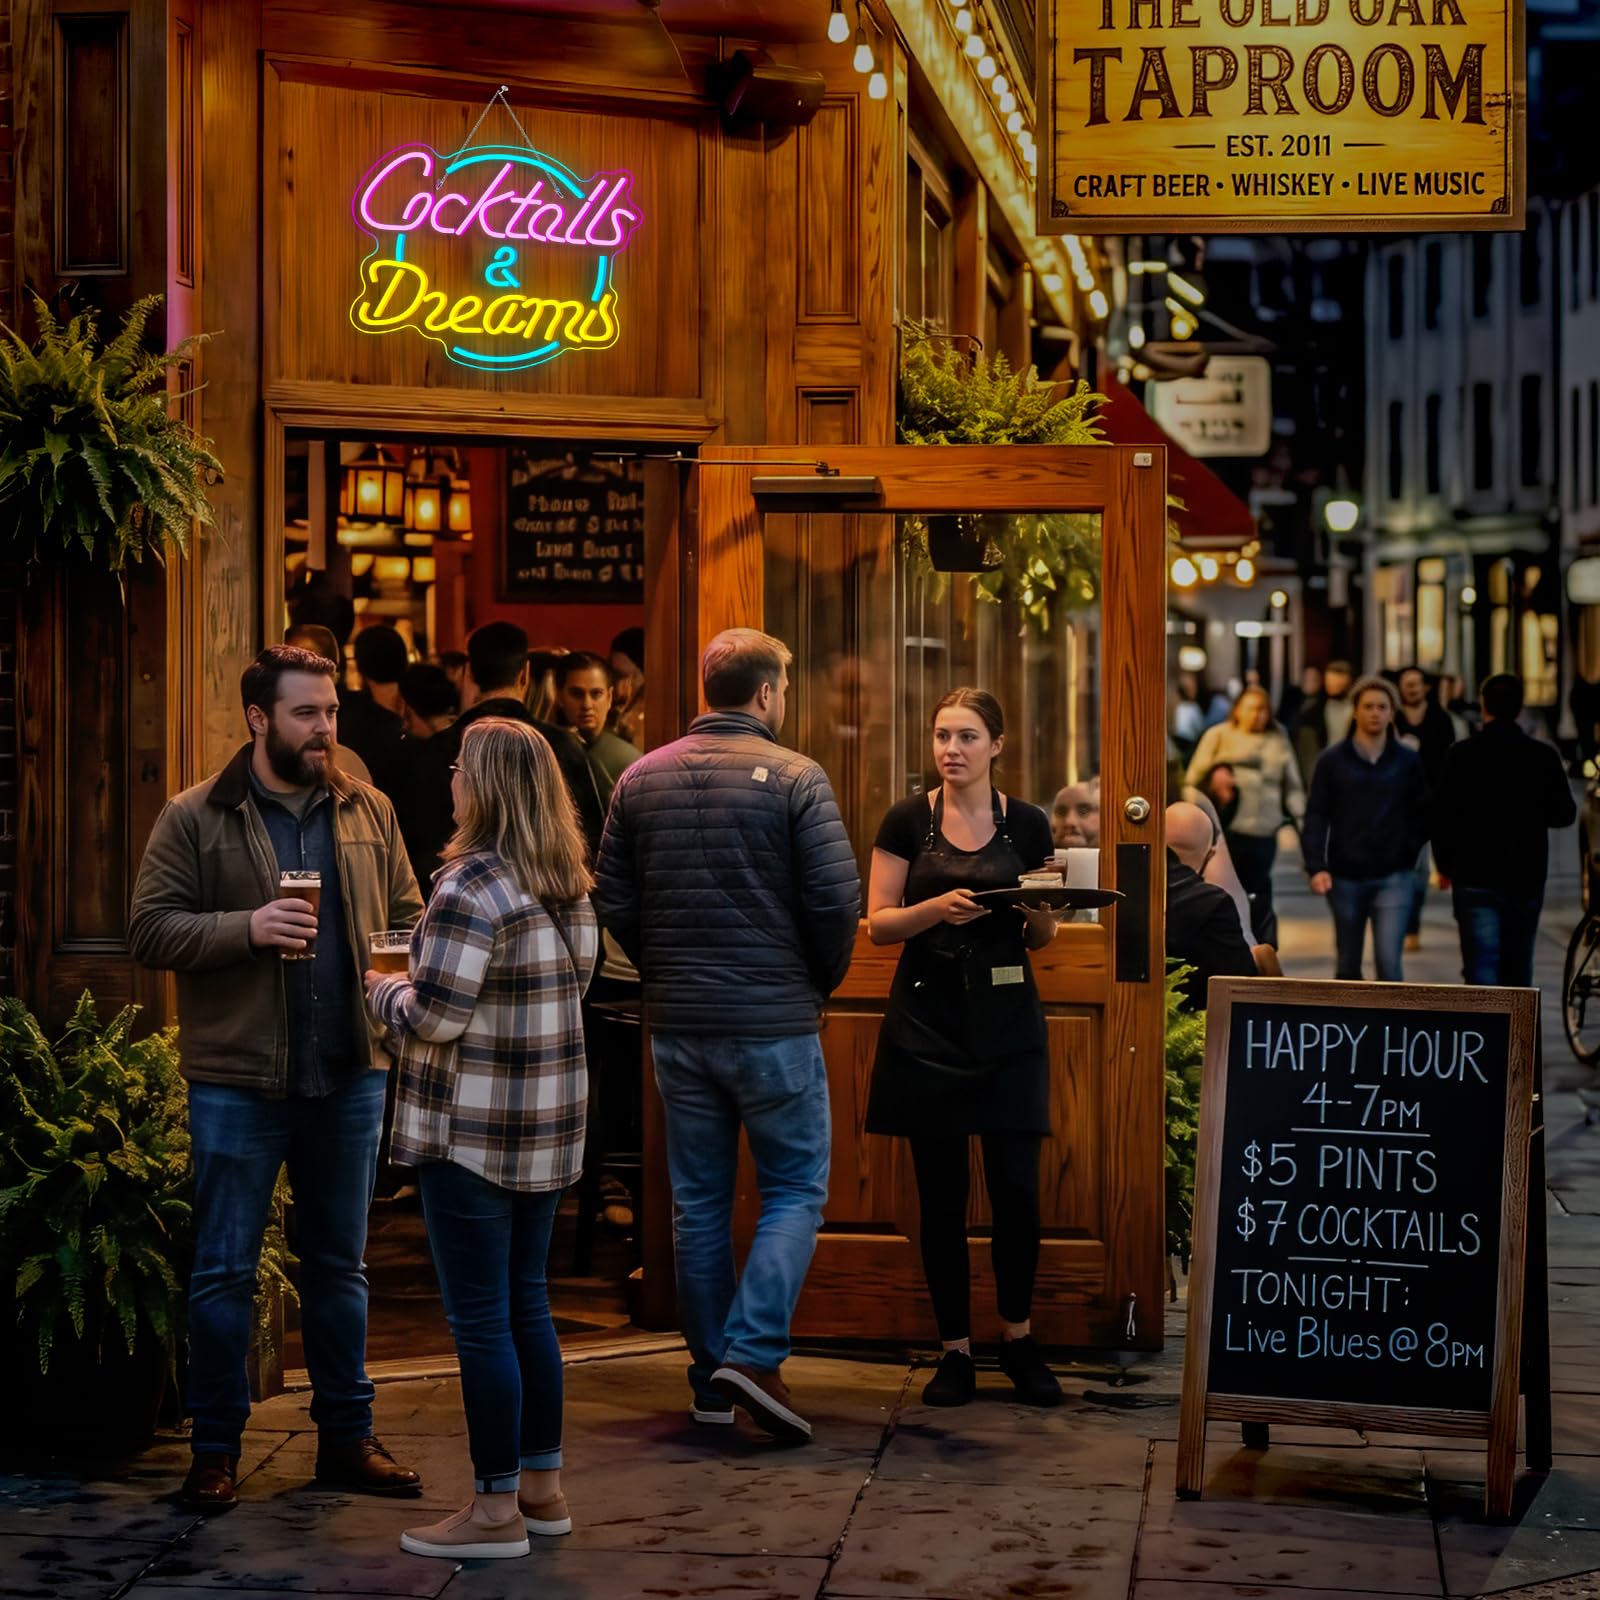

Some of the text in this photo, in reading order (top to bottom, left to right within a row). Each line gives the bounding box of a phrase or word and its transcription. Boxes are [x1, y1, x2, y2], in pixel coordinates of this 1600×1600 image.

[1073, 43, 1488, 127] TAPROOM
[1227, 135, 1332, 157] EST. 2011
[1074, 171, 1485, 198] CRAFT BEER WHISKEY LIVE MUSIC
[484, 246, 521, 288] &
[358, 259, 615, 343] Dreams
[1246, 1019, 1489, 1083] HAPPY HOUR
[1241, 1139, 1438, 1193] $5 PINTS
[1236, 1196, 1481, 1256] $7 COCKTAILS
[1230, 1268, 1410, 1313] TONIGHT:
[1225, 1313, 1484, 1369] Live Blues @ 8PM
